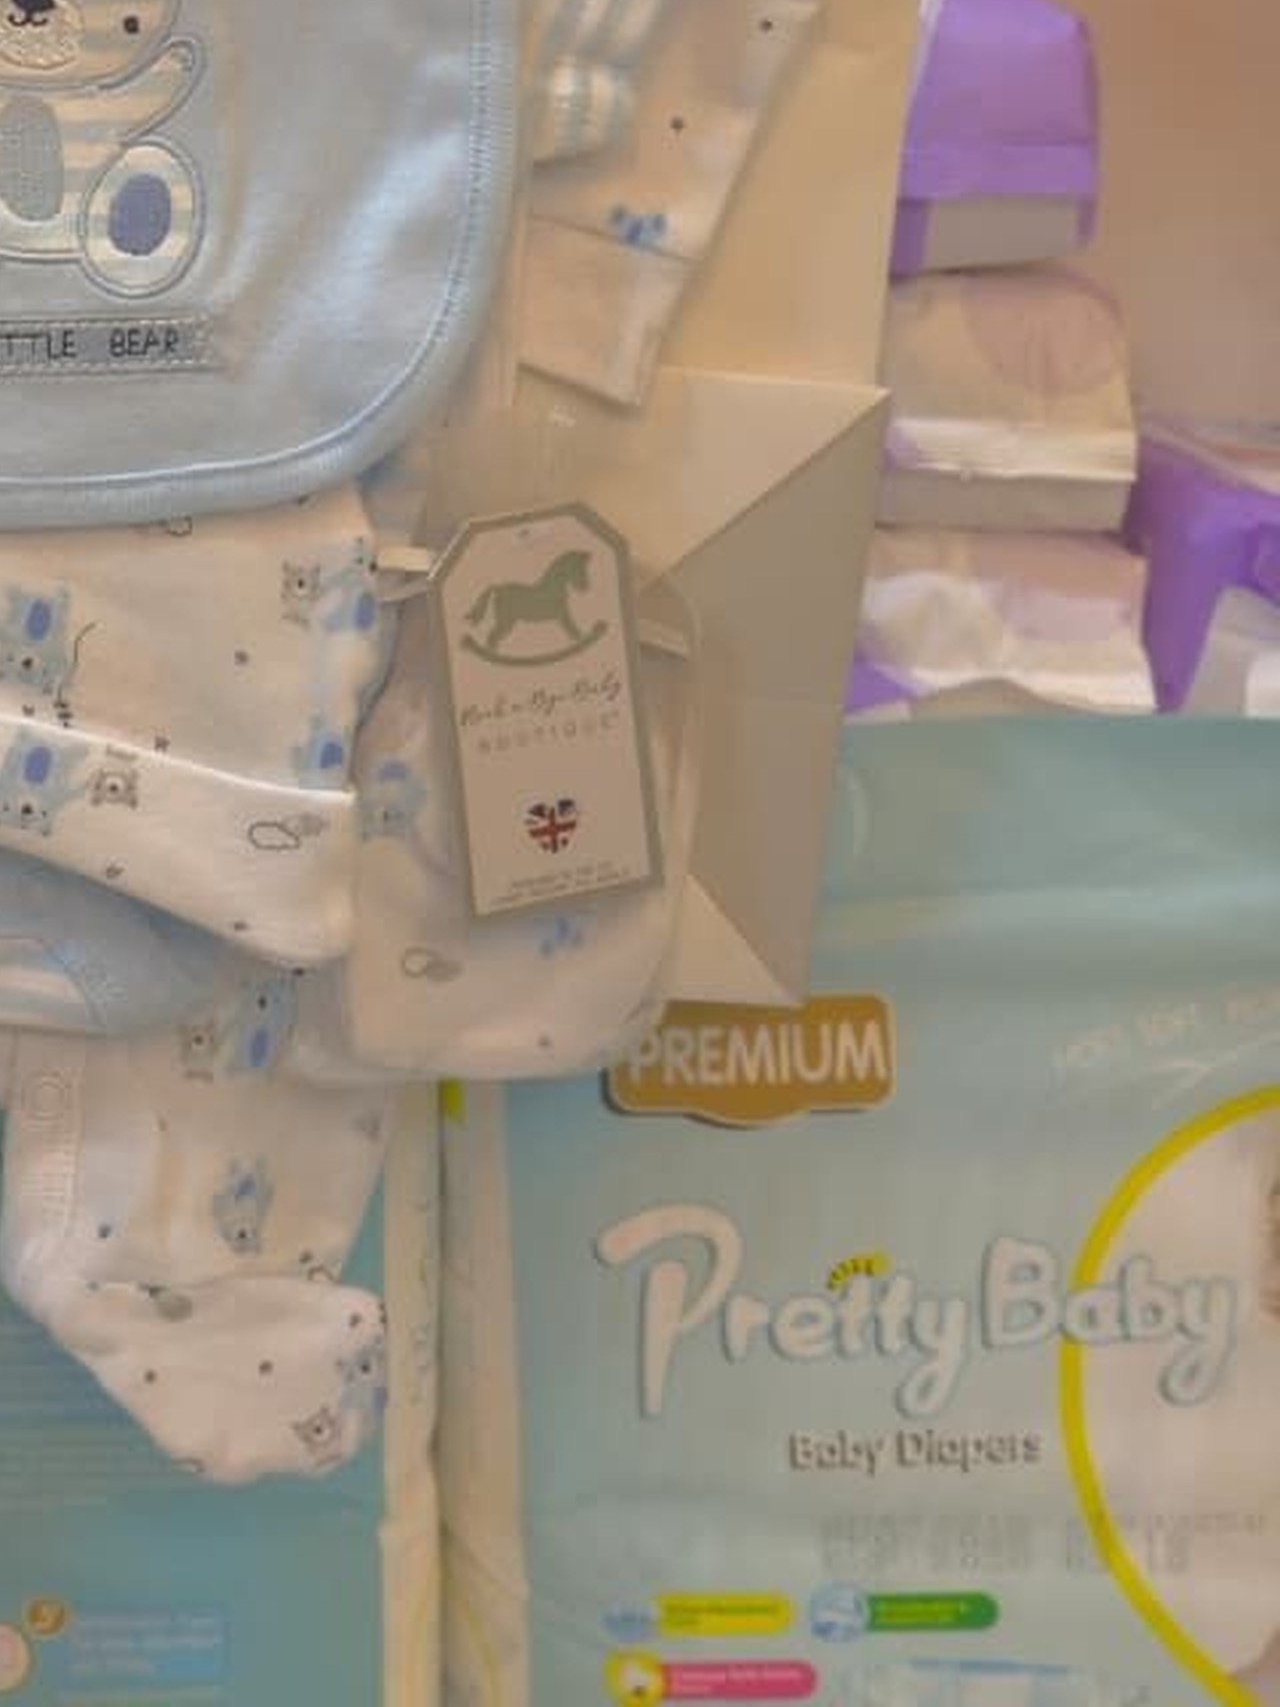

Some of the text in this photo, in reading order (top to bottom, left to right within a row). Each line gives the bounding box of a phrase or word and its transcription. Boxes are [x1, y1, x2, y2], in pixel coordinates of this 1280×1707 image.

[108, 326, 180, 358] BEAR
[628, 1017, 890, 1088] PREMIUM
[594, 1201, 1240, 1420] Pretty Baby
[788, 1428, 1043, 1478] Baby Diapers
